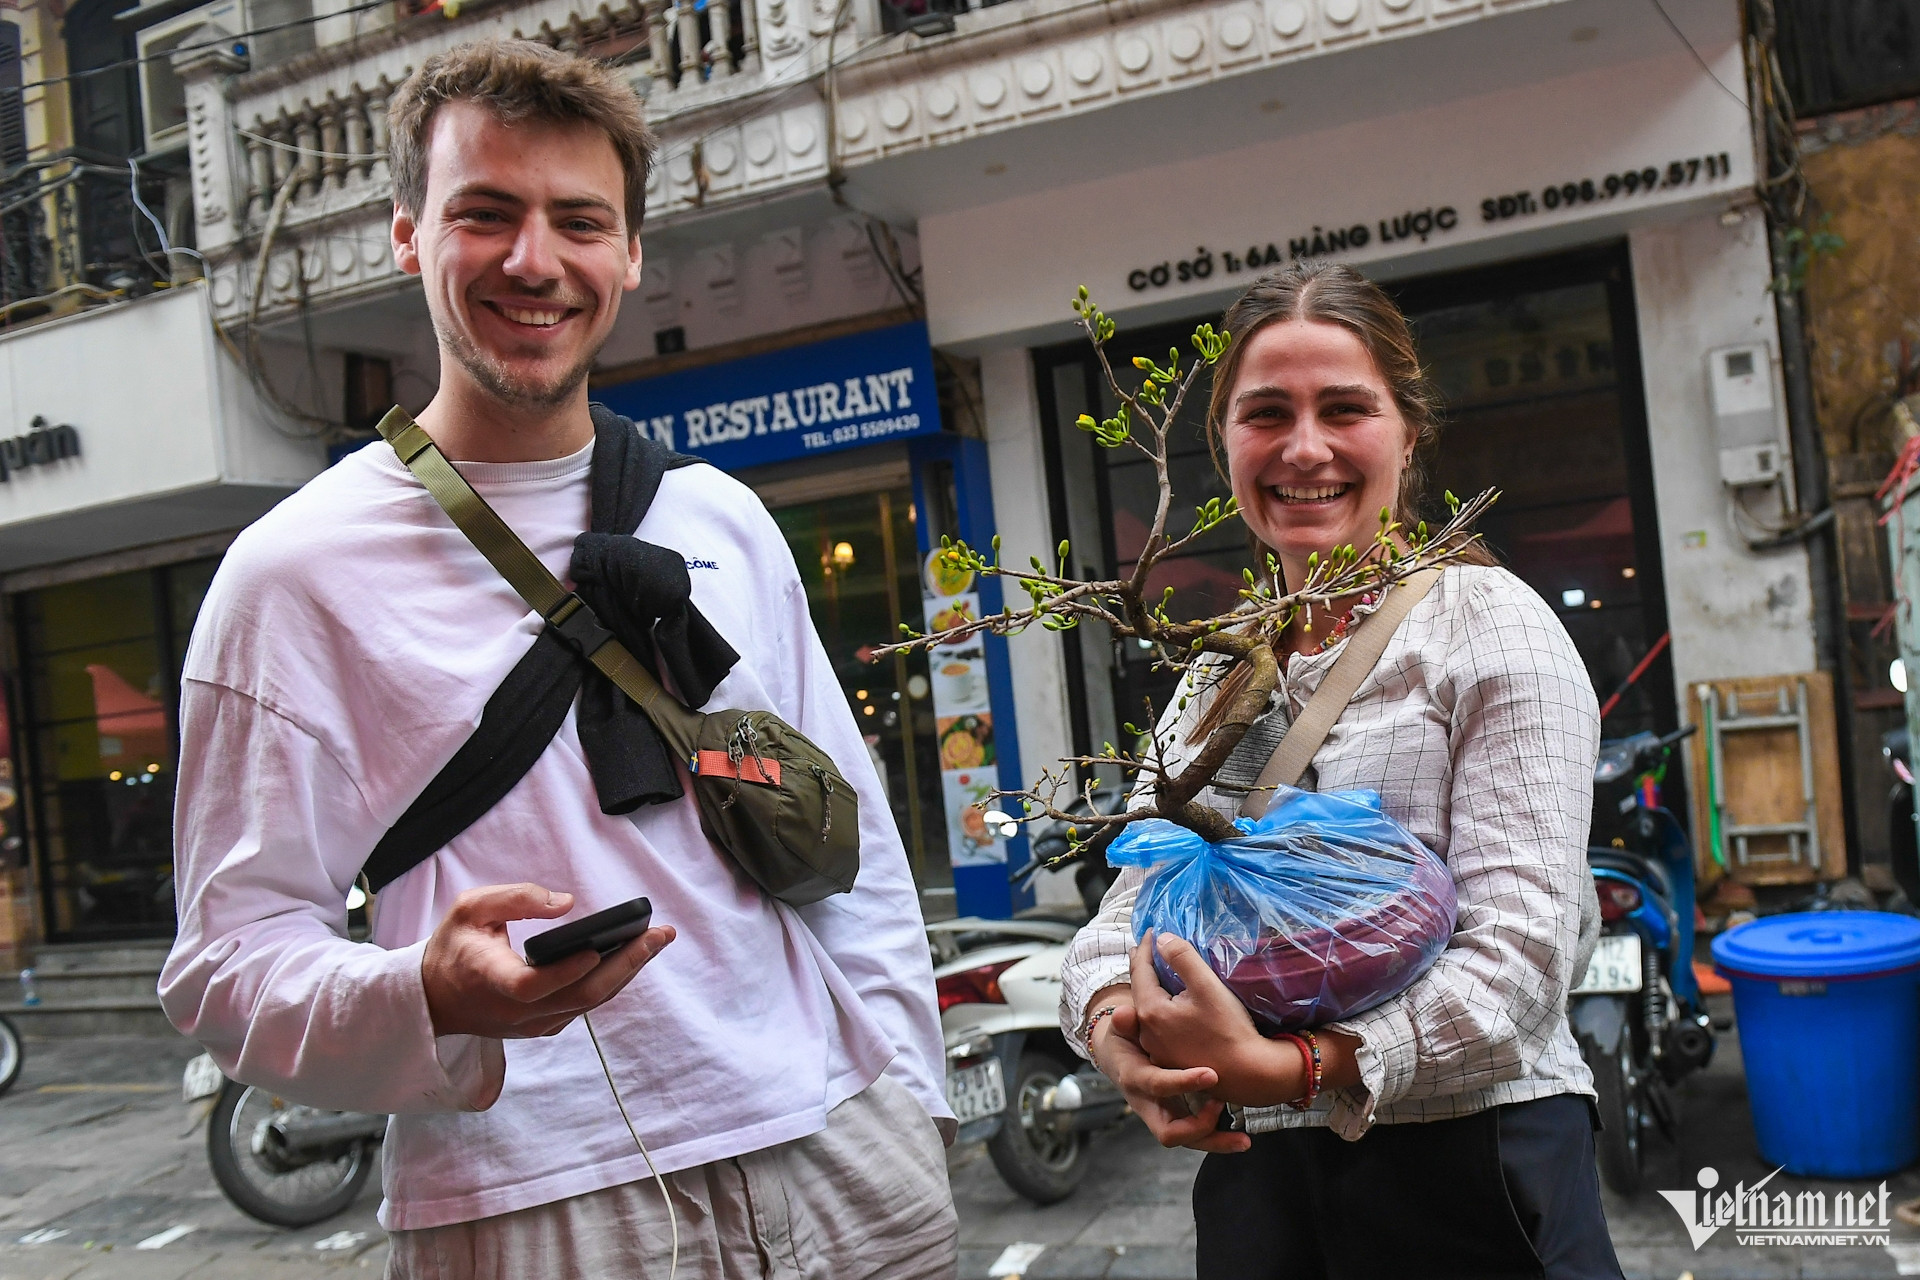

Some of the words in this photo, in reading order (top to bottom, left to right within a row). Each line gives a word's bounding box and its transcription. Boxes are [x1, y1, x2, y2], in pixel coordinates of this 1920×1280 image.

[1128, 261, 1170, 292] CƠ
[1177, 245, 1212, 283] SỞ
[1222, 251, 1241, 273] 1:
[1246, 243, 1281, 269] 6A
[1289, 225, 1370, 258] HÀNG
[1378, 205, 1458, 243] LƯỢC
[1543, 152, 1731, 210] 098.999.5711
[684, 367, 913, 448] RESTAURANT
[801, 431, 832, 449] TEL:
[832, 424, 859, 444] 033
